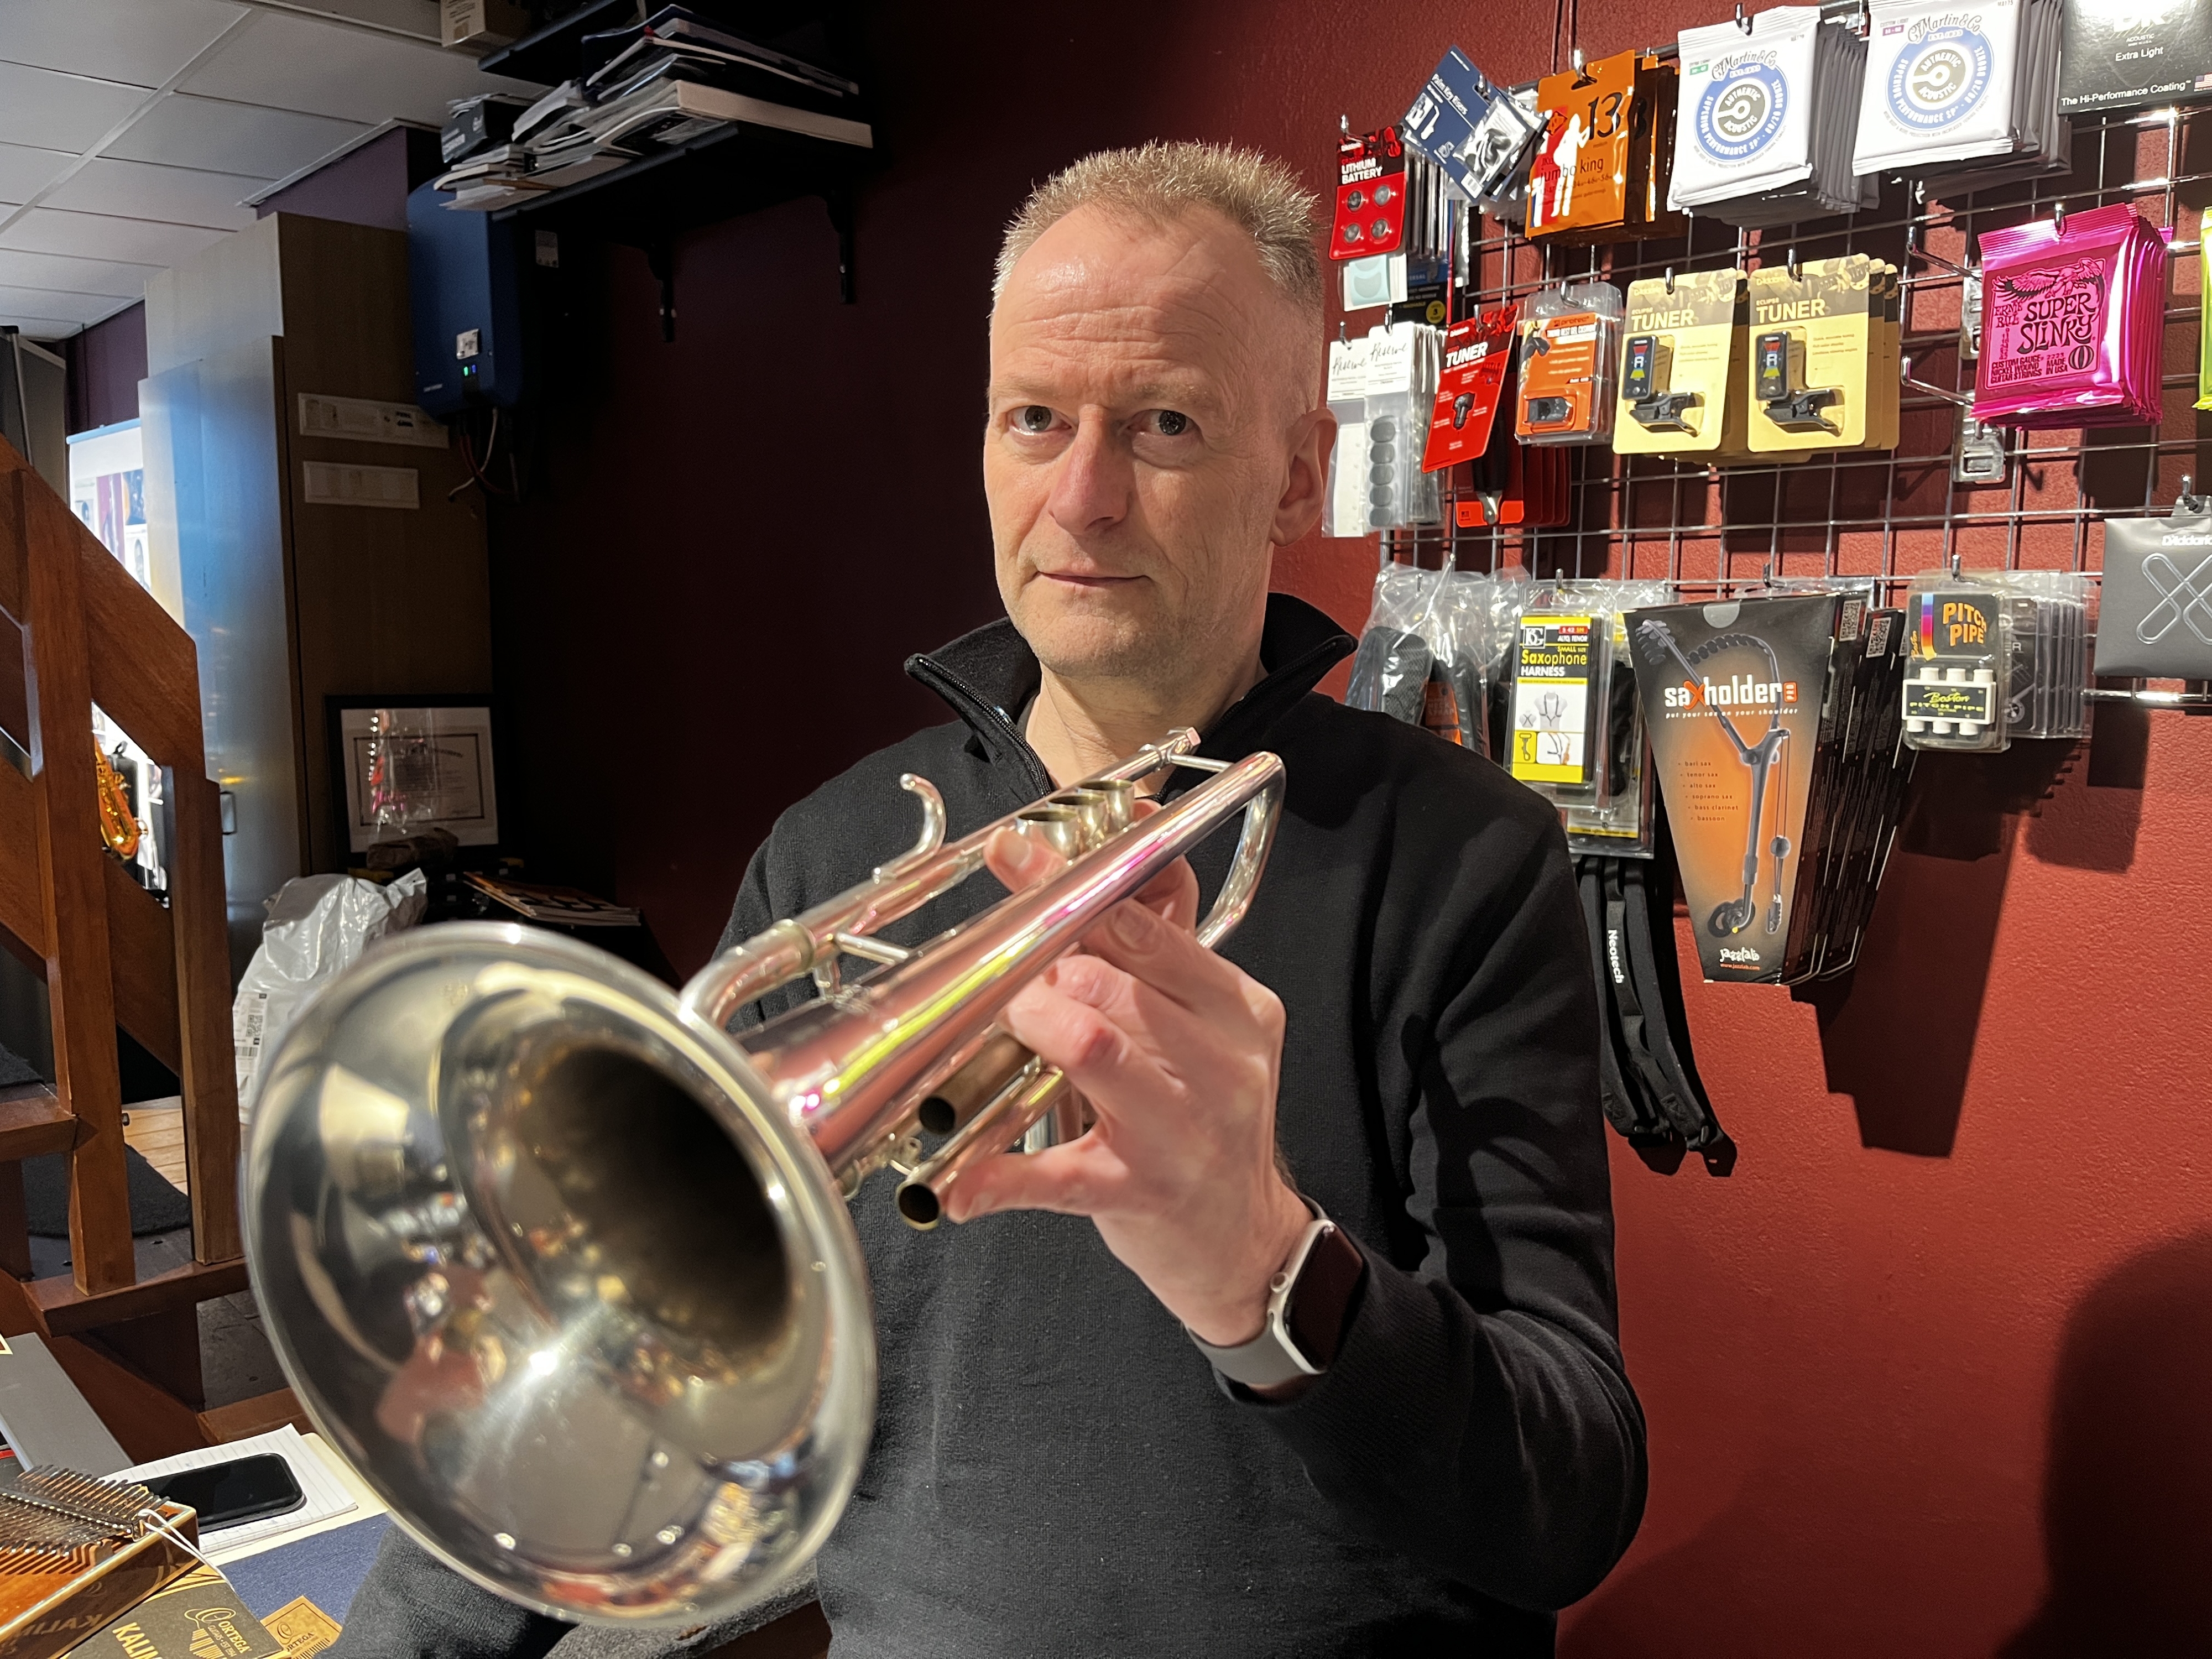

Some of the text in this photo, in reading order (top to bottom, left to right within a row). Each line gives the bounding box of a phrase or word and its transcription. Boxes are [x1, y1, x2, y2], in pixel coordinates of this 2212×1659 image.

[2126, 33, 2155, 43] ACOUSTIC
[1921, 52, 1961, 71] AUTHENTIC
[1974, 45, 1987, 77] BRONZE
[2115, 46, 2164, 61] Extra Light
[1892, 59, 1908, 99] SUPERIOR
[1724, 87, 1761, 106] AUTHENTIC
[1918, 82, 1957, 100] ACOUSTIC
[2061, 97, 2078, 106] The
[2080, 88, 2148, 104] Hi-Performance
[1588, 92, 1623, 140] 13
[1700, 96, 1714, 134] SUPERIOR
[1896, 98, 1944, 124] PERFORMANCE
[1723, 115, 1758, 133] ACOUSTIC
[1704, 133, 1747, 155] PERFORMANCE
[1342, 158, 1376, 174] LITHIUM
[1342, 166, 1383, 184] BATTERY
[1539, 157, 1604, 186] jumbo king
[1631, 307, 1653, 315] ECLIPSE
[1756, 297, 1779, 306] ECLIPSE
[1756, 298, 1825, 324] TUNER
[2023, 293, 2096, 321] SUPER
[1631, 309, 1694, 331] TUNER
[1446, 342, 1488, 368] TUNER
[2047, 358, 2066, 367] MADE
[2055, 365, 2068, 373] USA
[1943, 602, 1987, 633] PITCH
[1525, 628, 1544, 646] BG
[1950, 624, 1984, 647] PIPE
[1521, 649, 1587, 667] Saxophone
[1521, 666, 1565, 677] HARNESS
[1923, 692, 1970, 703] Boston
[1608, 930, 1624, 983] Neotech
[1719, 946, 1760, 962] jazzlab
[218, 1621, 251, 1653] ORTEGA
